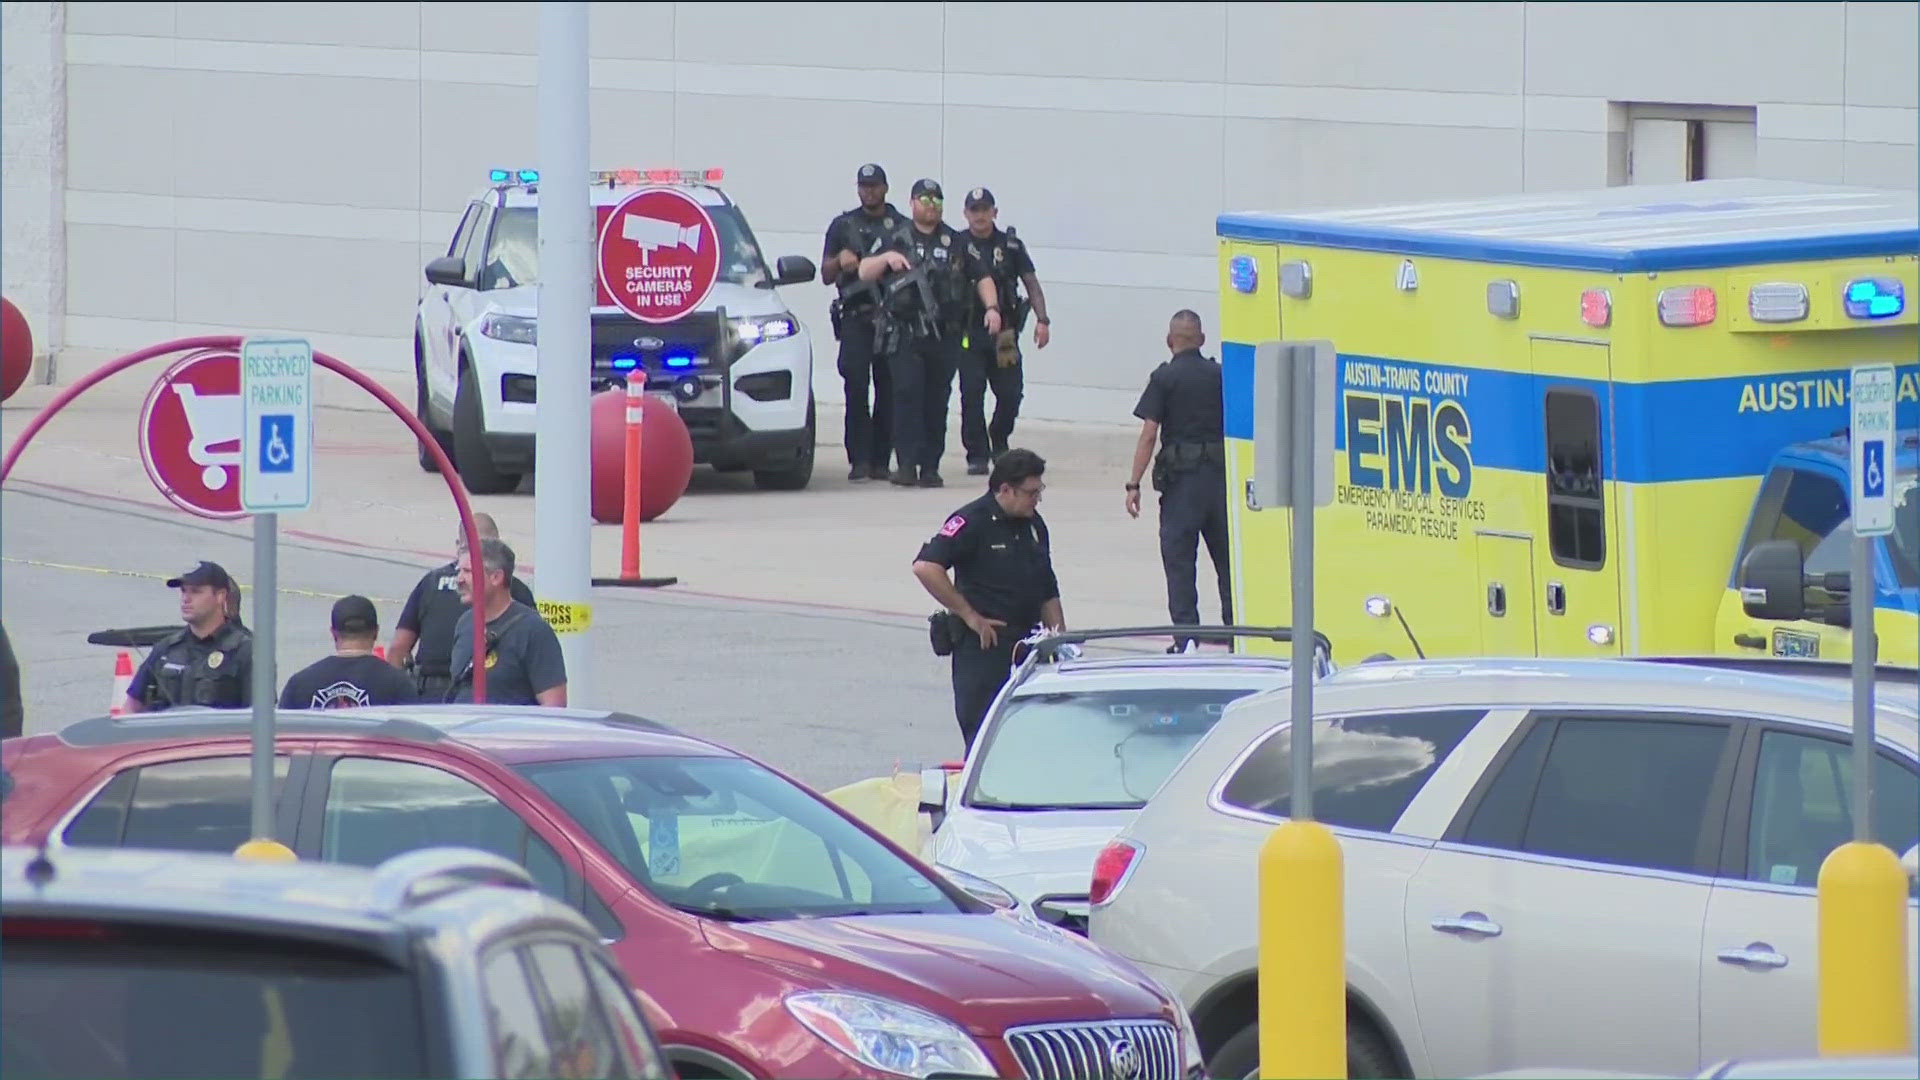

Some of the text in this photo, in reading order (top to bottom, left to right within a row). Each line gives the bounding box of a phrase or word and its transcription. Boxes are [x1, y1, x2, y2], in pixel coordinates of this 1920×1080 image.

[625, 265, 693, 280] SECURITY
[626, 280, 693, 294] CAMERAS
[636, 293, 682, 307] IN USE
[248, 354, 307, 377] RESERVED
[1344, 361, 1469, 397] AUSTIN-TRAVIS COUNTY
[251, 383, 303, 406] PARKING
[1344, 389, 1472, 501] EMS
[1338, 484, 1486, 522] EMERGENCY MEDICAL SERVICES
[1366, 511, 1458, 541] PARAMEDIC RESCUE
